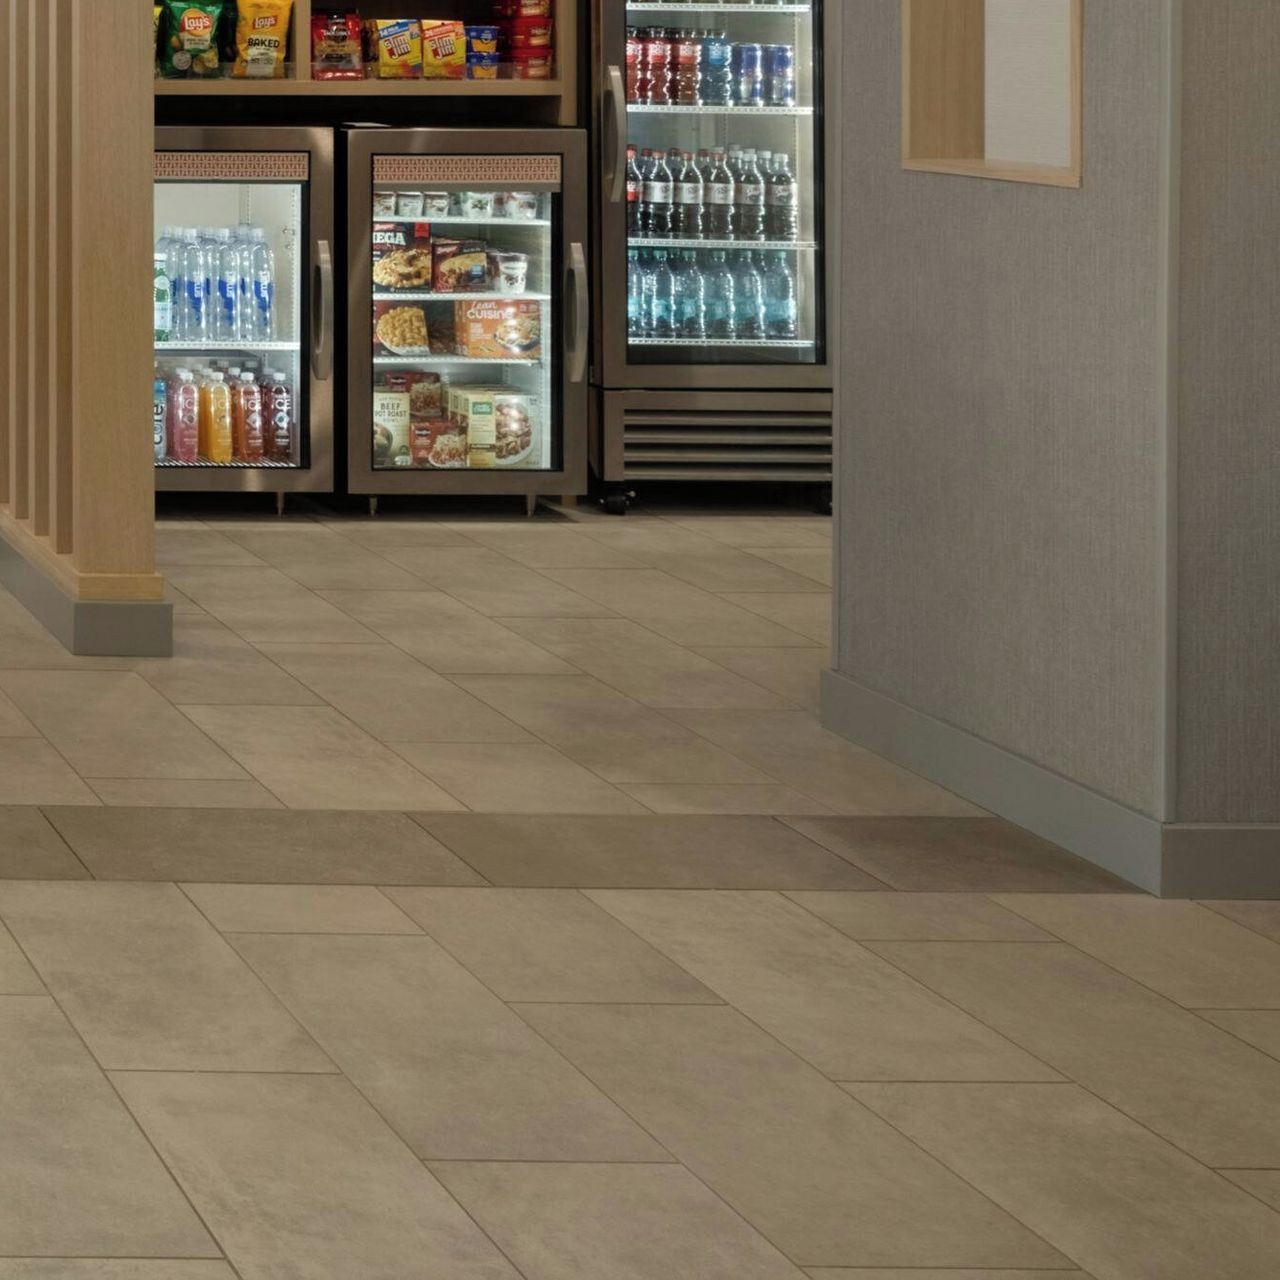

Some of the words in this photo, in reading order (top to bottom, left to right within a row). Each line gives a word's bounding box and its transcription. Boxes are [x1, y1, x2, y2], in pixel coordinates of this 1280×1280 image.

[183, 15, 210, 32] Lay's
[248, 37, 280, 48] BAKED
[380, 402, 401, 410] BEEF
